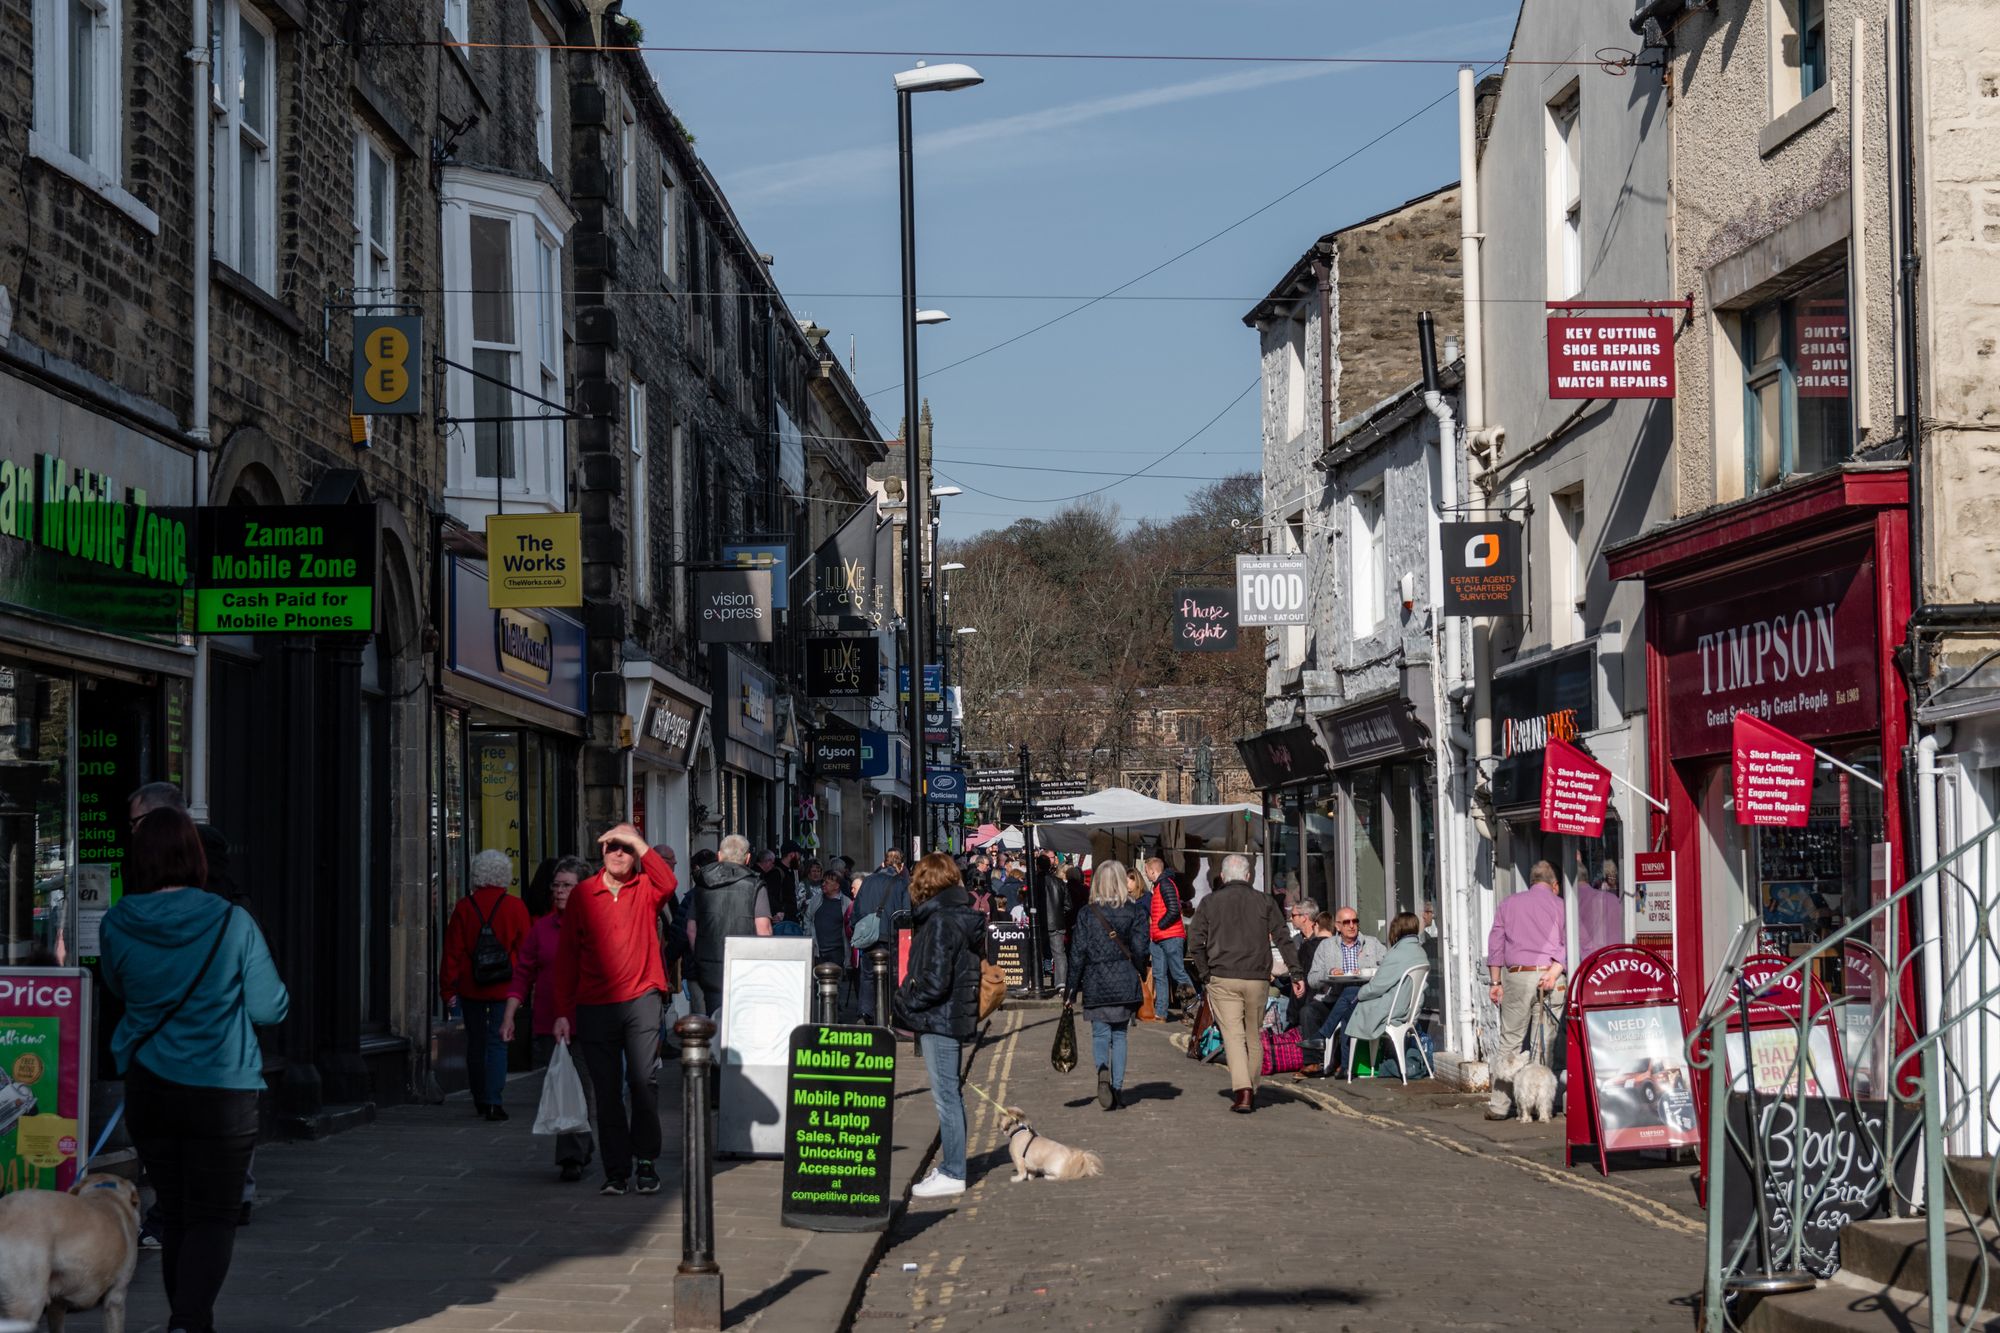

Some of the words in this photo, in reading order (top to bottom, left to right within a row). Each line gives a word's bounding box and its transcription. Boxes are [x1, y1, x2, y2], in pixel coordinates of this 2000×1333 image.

[1566, 328, 1590, 340] KEY
[1598, 327, 1656, 340] CUTTING
[1563, 344, 1597, 356] SHOE
[1604, 344, 1660, 356] REPAIRS
[1573, 360, 1651, 372] ENGRAVING
[1558, 376, 1604, 388] WATCH
[1610, 376, 1668, 388] REPAIRS
[43, 453, 125, 569] Mobile
[133, 487, 187, 586] Zone
[245, 522, 323, 547] Zaman
[516, 534, 552, 551] The
[212, 556, 291, 580] Mobile
[300, 554, 356, 578] Zone
[503, 554, 566, 572] Works
[826, 558, 866, 591] LUXE
[1483, 576, 1516, 584] AGENTS
[507, 578, 562, 586] TheWorks.co.uk
[1464, 584, 1512, 592] CHARTERED
[712, 592, 754, 606] vision
[1242, 574, 1303, 611] FOOD
[1460, 593, 1508, 601] SURVEYORS
[222, 592, 269, 608] Cash
[276, 592, 316, 606] Paid
[322, 592, 348, 606] for
[704, 608, 762, 622] express
[1180, 598, 1229, 620] Phase
[217, 614, 278, 628] Mobile
[284, 611, 354, 628] Phones
[1182, 622, 1228, 646] Eight
[824, 640, 861, 670] LUXE
[1698, 603, 1836, 695] TIMPSON
[1836, 690, 1846, 704] Est
[1706, 710, 1728, 727] Great
[1760, 700, 1772, 721] By
[1774, 696, 1797, 716] Great
[1799, 689, 1828, 712] People
[818, 746, 855, 760] dyson
[1750, 750, 1770, 760] Shoe
[1772, 750, 1800, 760] Repairs
[1558, 768, 1574, 778] Shoe
[1576, 769, 1600, 780] Repairs
[1749, 764, 1764, 773] Key
[1766, 764, 1794, 774] Cutting
[483, 775, 506, 784] ollect
[1556, 779, 1569, 790] Key
[1570, 780, 1594, 792] Cutting
[1748, 776, 1774, 785] Watch
[1776, 777, 1806, 788] Repairs
[1556, 790, 1576, 799] Watch
[1577, 792, 1602, 803] Repairs
[1748, 788, 1788, 800] Engraving
[1554, 800, 1587, 812] Engraving
[1747, 801, 1773, 811] Phone
[1774, 802, 1806, 812] Repairs
[1552, 810, 1574, 821] Phone
[1575, 812, 1600, 824] Repairs
[1557, 822, 1585, 831] TIMPSON
[1642, 862, 1664, 872] TIMPSON
[1654, 900, 1670, 910] PRICE
[1649, 913, 1658, 921] KEY
[1658, 912, 1670, 921] DEAL
[992, 928, 1025, 942] dyson
[1588, 959, 1666, 986] TIMPSON
[1608, 1018, 1646, 1032] NEED
[1650, 1017, 1660, 1028] A
[0, 1030, 46, 1046] alliams
[818, 1028, 872, 1046] Zaman
[796, 1048, 850, 1068] Mobile
[854, 1051, 894, 1070] Zone
[794, 1089, 840, 1106] Mobile
[844, 1090, 886, 1108] Phone
[808, 1110, 820, 1126] &
[824, 1110, 870, 1130] Laptop
[796, 1130, 836, 1144] Sales,
[838, 1131, 880, 1146] Repair
[800, 1146, 864, 1162] Unlocking
[866, 1148, 876, 1161] &
[798, 1162, 876, 1176] Accessories
[832, 1178, 842, 1188] at
[792, 1190, 848, 1204] competitive
[850, 1192, 880, 1204] prices
